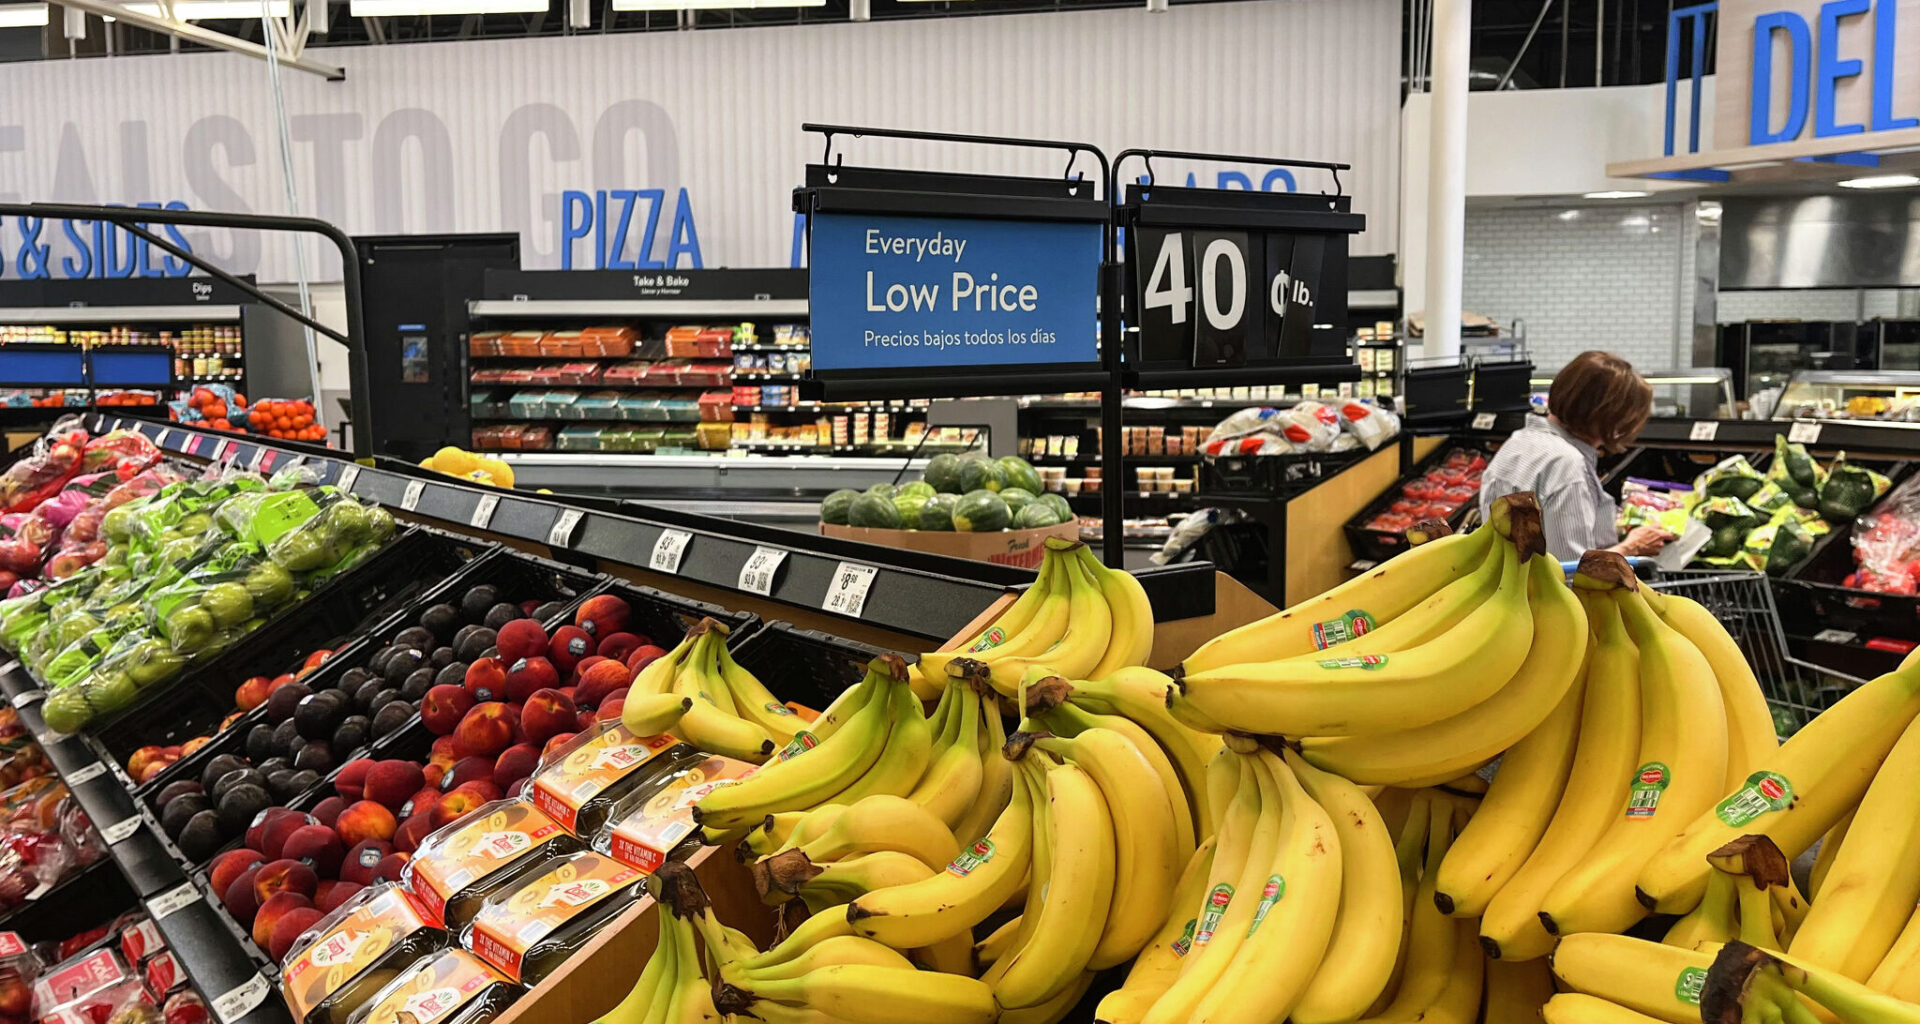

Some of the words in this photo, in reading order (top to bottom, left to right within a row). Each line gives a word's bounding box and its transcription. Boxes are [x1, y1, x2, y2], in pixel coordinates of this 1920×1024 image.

[291, 107, 455, 283] TO
[500, 99, 681, 268] GO
[17, 212, 51, 280] &
[62, 201, 194, 280] SIDES
[562, 187, 704, 270] PIZZA
[866, 229, 966, 263] Everyday
[192, 282, 213, 295] Dips
[633, 276, 655, 287] Take
[657, 276, 665, 287] &
[666, 276, 690, 287] Bake
[866, 271, 939, 312] Low
[952, 271, 1038, 312] Price
[1145, 232, 1247, 331] 40
[1292, 280, 1314, 307] lb.
[865, 330, 920, 348] Precios
[924, 330, 961, 350] bajos
[965, 329, 1004, 345] todos
[1008, 329, 1027, 344] los
[1030, 328, 1056, 344] días
[544, 793, 552, 805] THE
[551, 797, 567, 814] VITAMIN
[633, 843, 651, 859] VITAMIN
[485, 936, 493, 949] THE
[492, 940, 509, 959] VITAMIN
